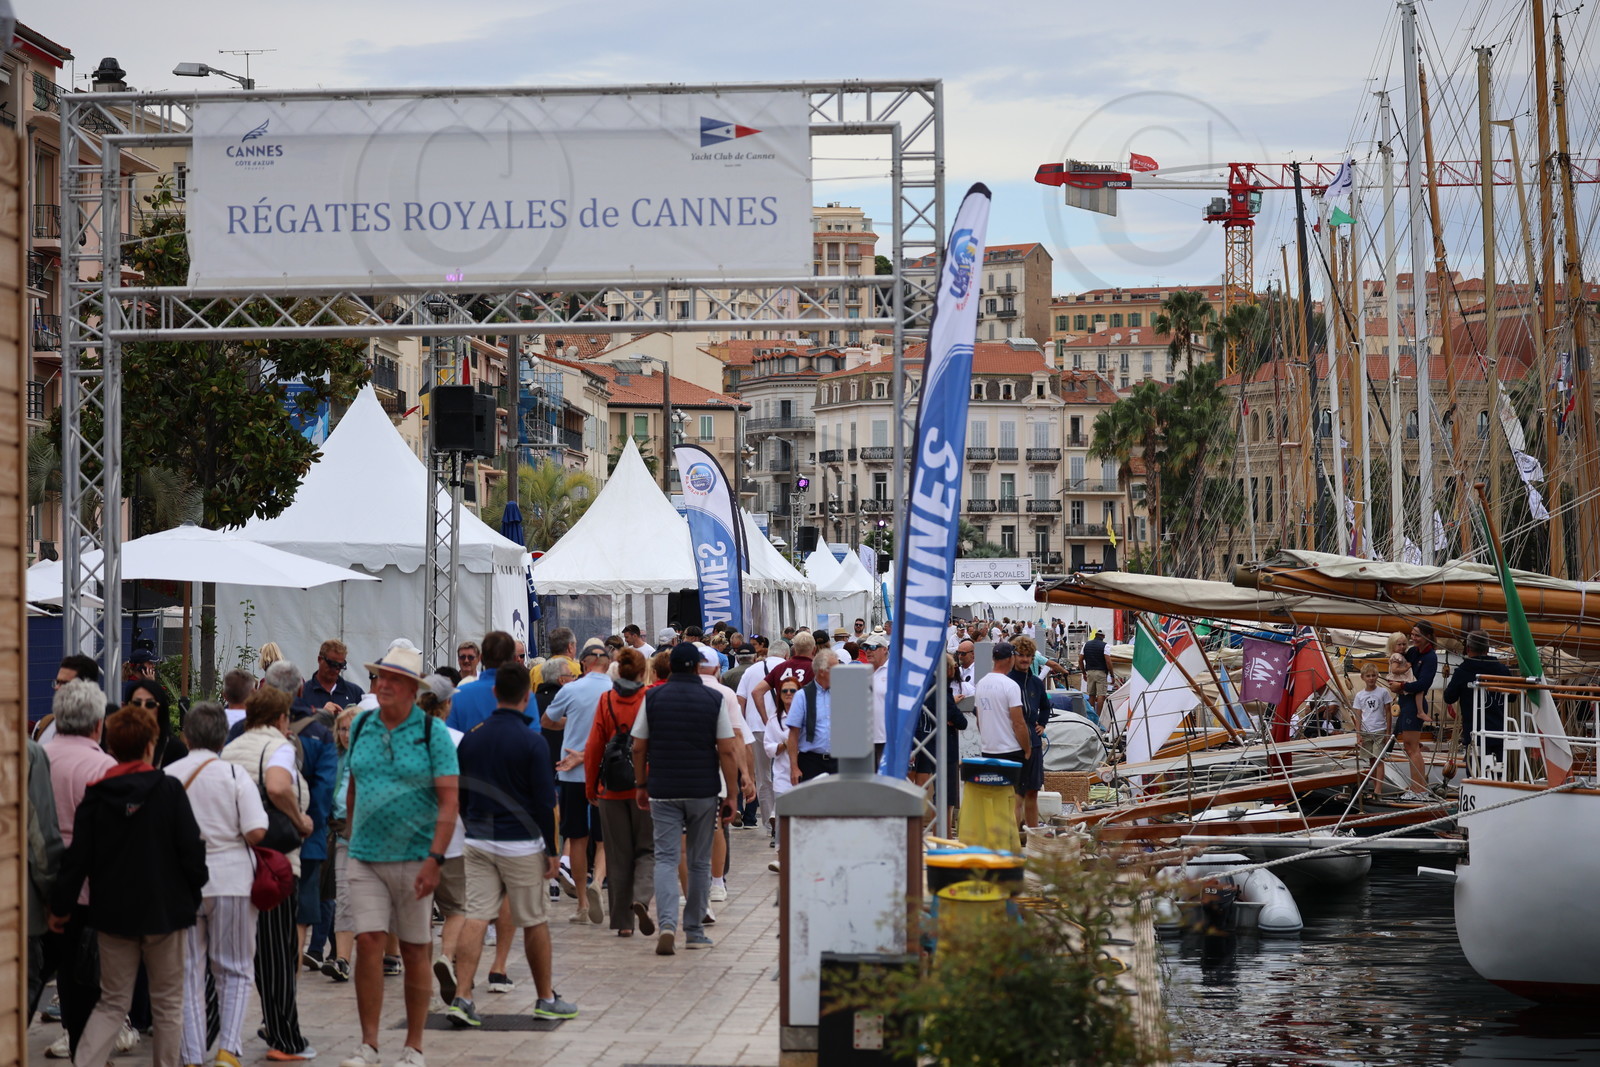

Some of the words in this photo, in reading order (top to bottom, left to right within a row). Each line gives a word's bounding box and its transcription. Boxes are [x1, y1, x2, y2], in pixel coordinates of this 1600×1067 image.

[226, 145, 283, 158] CANNES
[691, 152, 712, 161] Yacht
[714, 152, 733, 160] Club
[735, 152, 744, 160] de
[746, 152, 776, 160] Cannes
[227, 197, 391, 234] RÉGATES
[403, 200, 568, 231] ROYALES
[579, 198, 620, 228] de
[631, 196, 778, 227] CANNES
[961, 571, 992, 579] REGATES
[993, 571, 1025, 579] ROYALES
